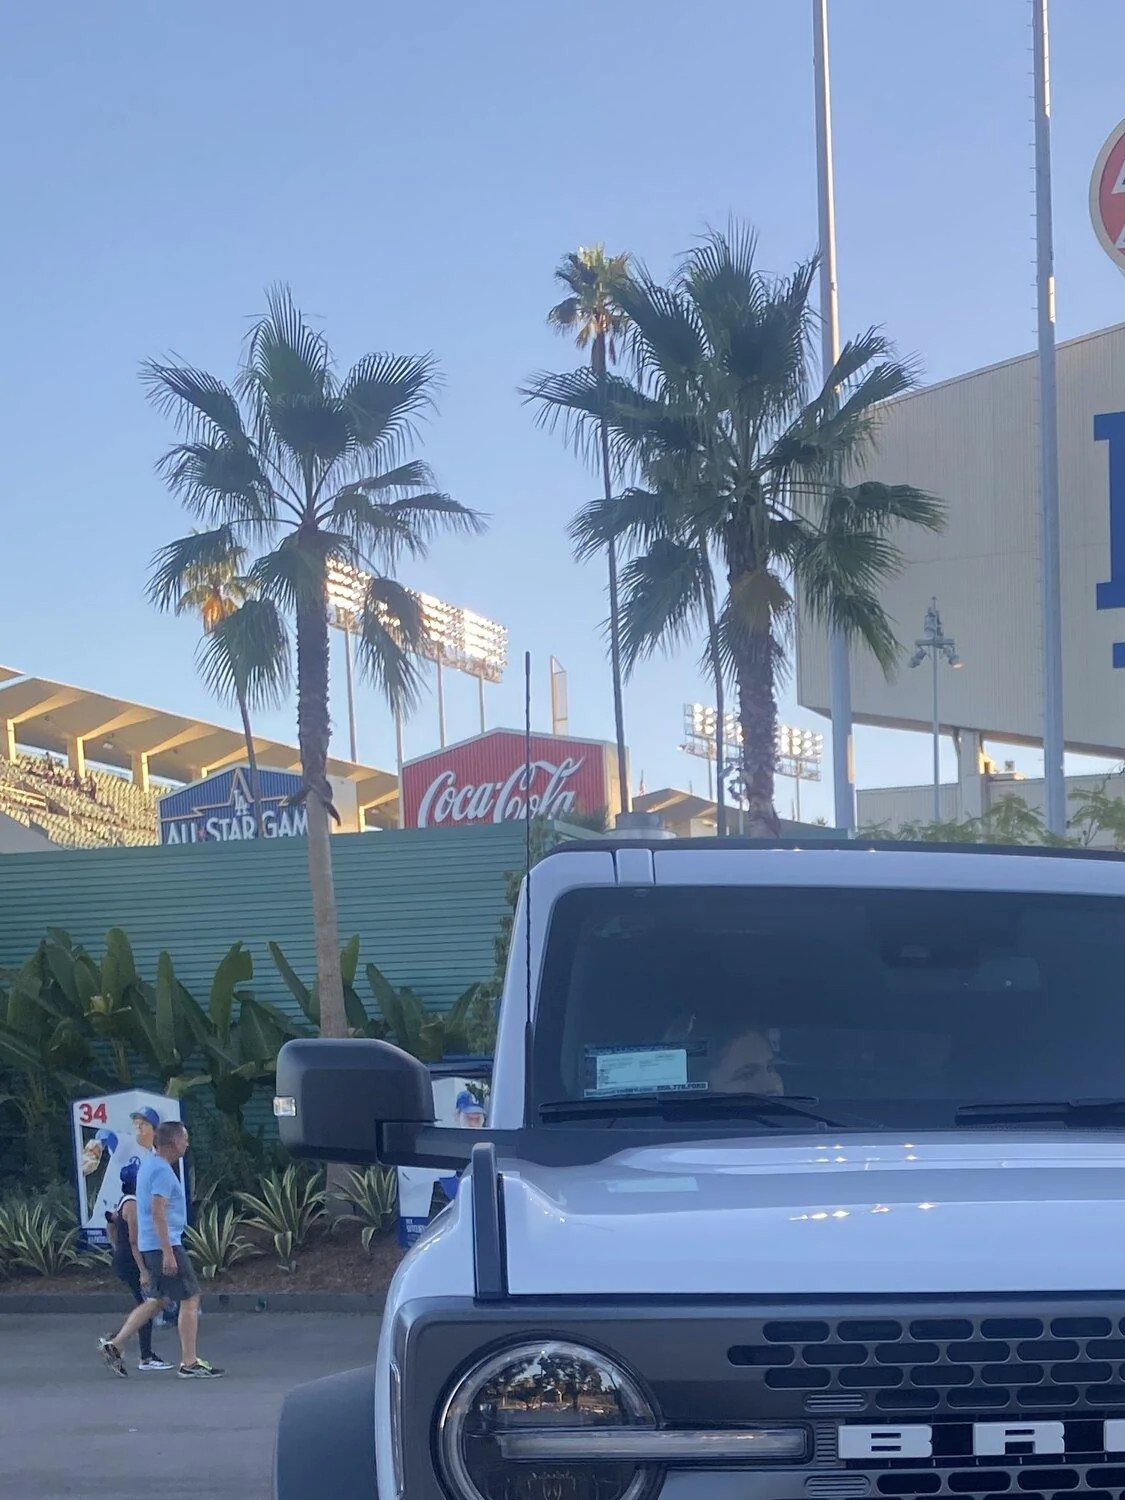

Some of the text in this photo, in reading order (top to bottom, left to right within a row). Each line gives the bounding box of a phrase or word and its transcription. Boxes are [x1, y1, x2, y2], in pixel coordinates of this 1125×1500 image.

[417, 754, 586, 829] Coca-Cola
[205, 815, 256, 842] STAR
[261, 808, 309, 839] GAM
[79, 1103, 107, 1124] 34
